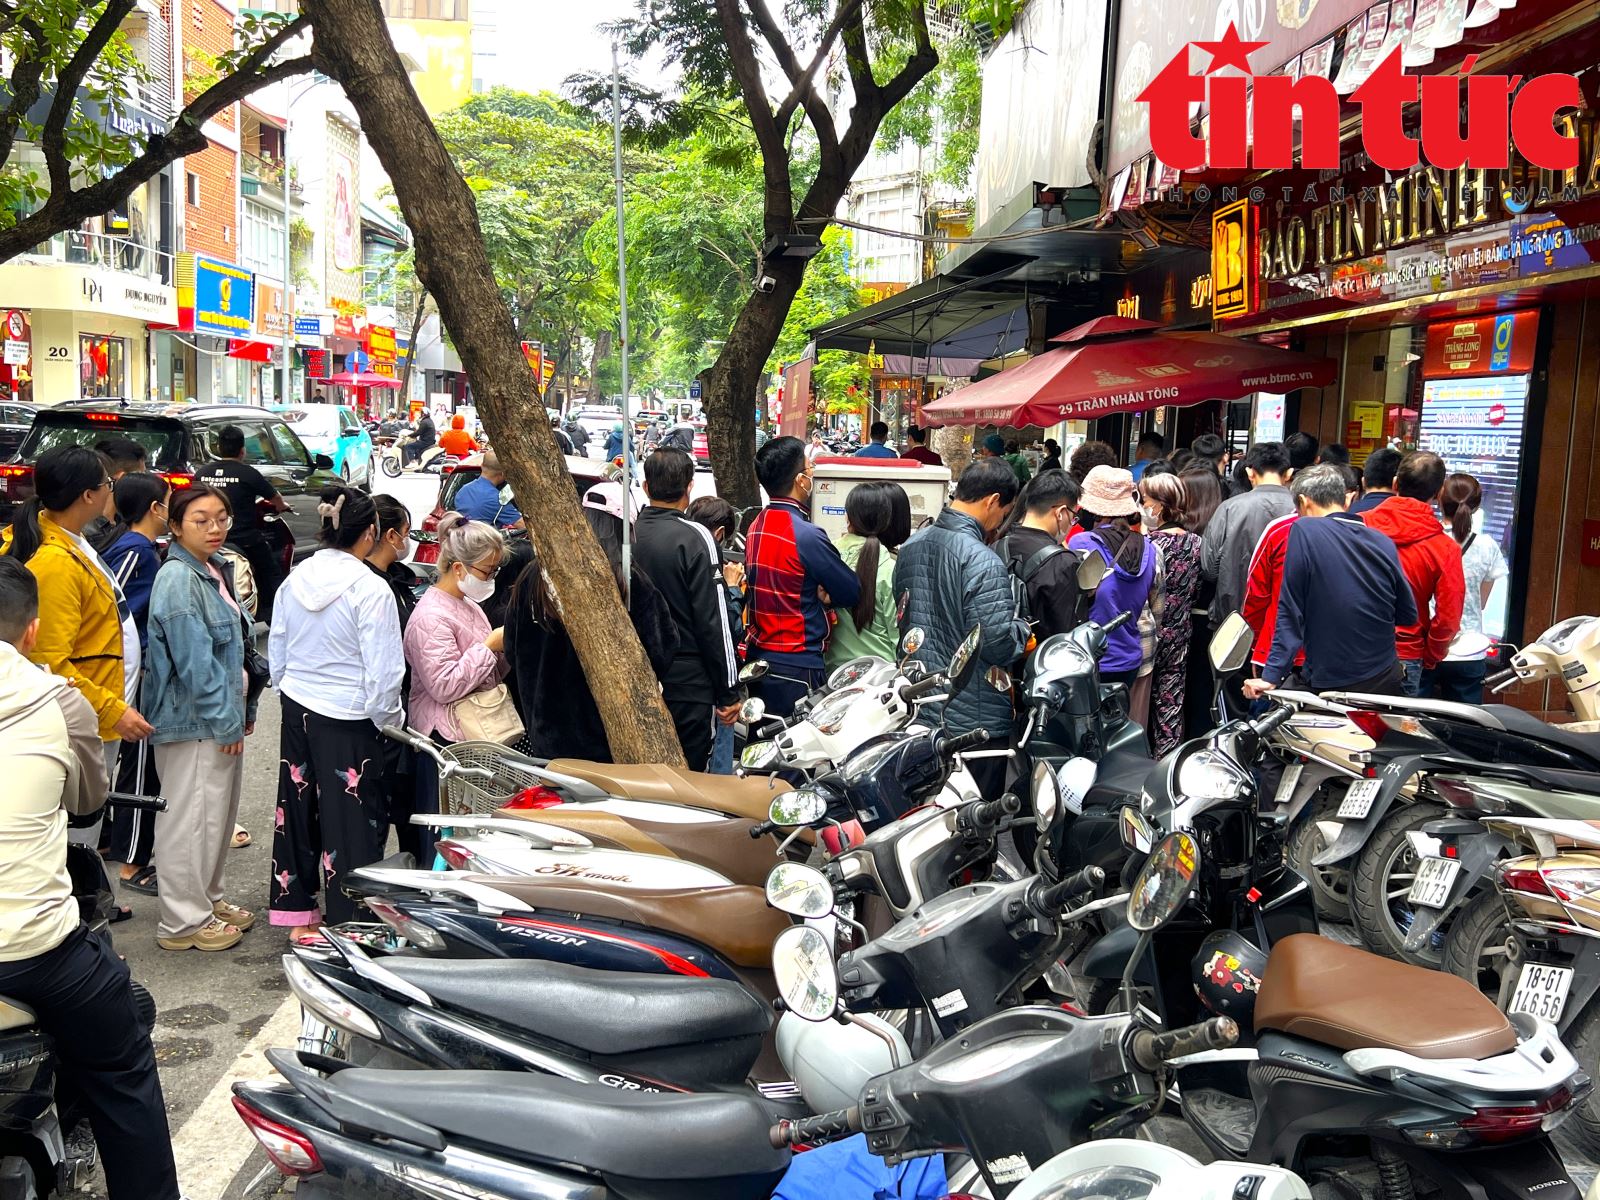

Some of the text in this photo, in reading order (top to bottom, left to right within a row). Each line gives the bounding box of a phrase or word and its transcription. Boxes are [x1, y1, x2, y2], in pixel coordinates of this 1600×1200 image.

[1259, 199, 1307, 280] BẢO
[1372, 158, 1488, 251] MINH
[49, 347, 68, 357] 20
[1445, 341, 1480, 353] THĂNG LONG
[1241, 371, 1313, 387] www.btmc.vn
[1058, 386, 1179, 415] 29 TRẦN NHÂN TÔNG
[1455, 432, 1482, 455] TÍCH
[584, 872, 632, 883] mode
[1420, 859, 1453, 881] 29-M1
[1410, 880, 1447, 904] 901.73
[496, 922, 588, 947] VISION
[1526, 966, 1564, 993] 18-G1
[1514, 990, 1561, 1019] 146.56
[1528, 1179, 1568, 1192] HONDA
